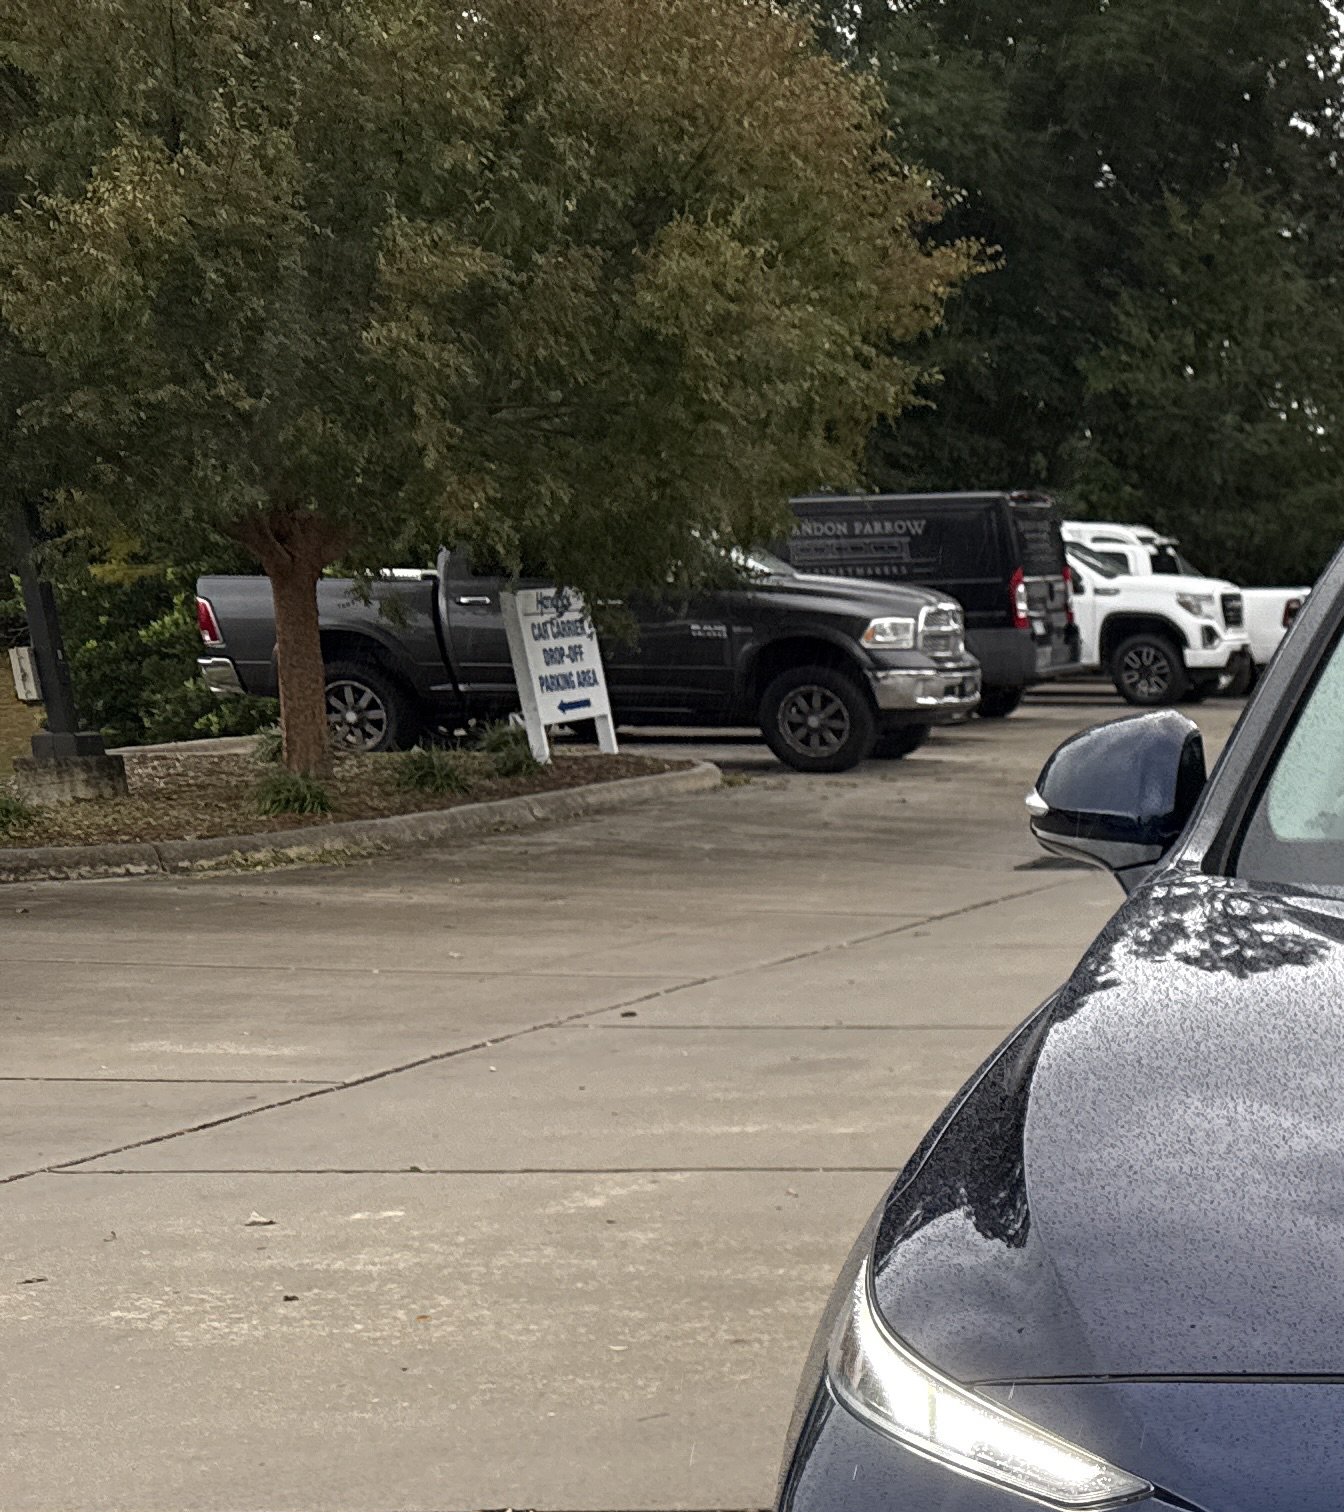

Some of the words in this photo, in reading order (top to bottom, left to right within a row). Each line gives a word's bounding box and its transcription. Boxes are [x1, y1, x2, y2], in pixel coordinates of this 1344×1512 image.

[531, 621, 550, 641] CAR
[542, 644, 584, 667] DROP-OFF
[538, 670, 576, 694] PARKING
[575, 668, 599, 689] AREA
